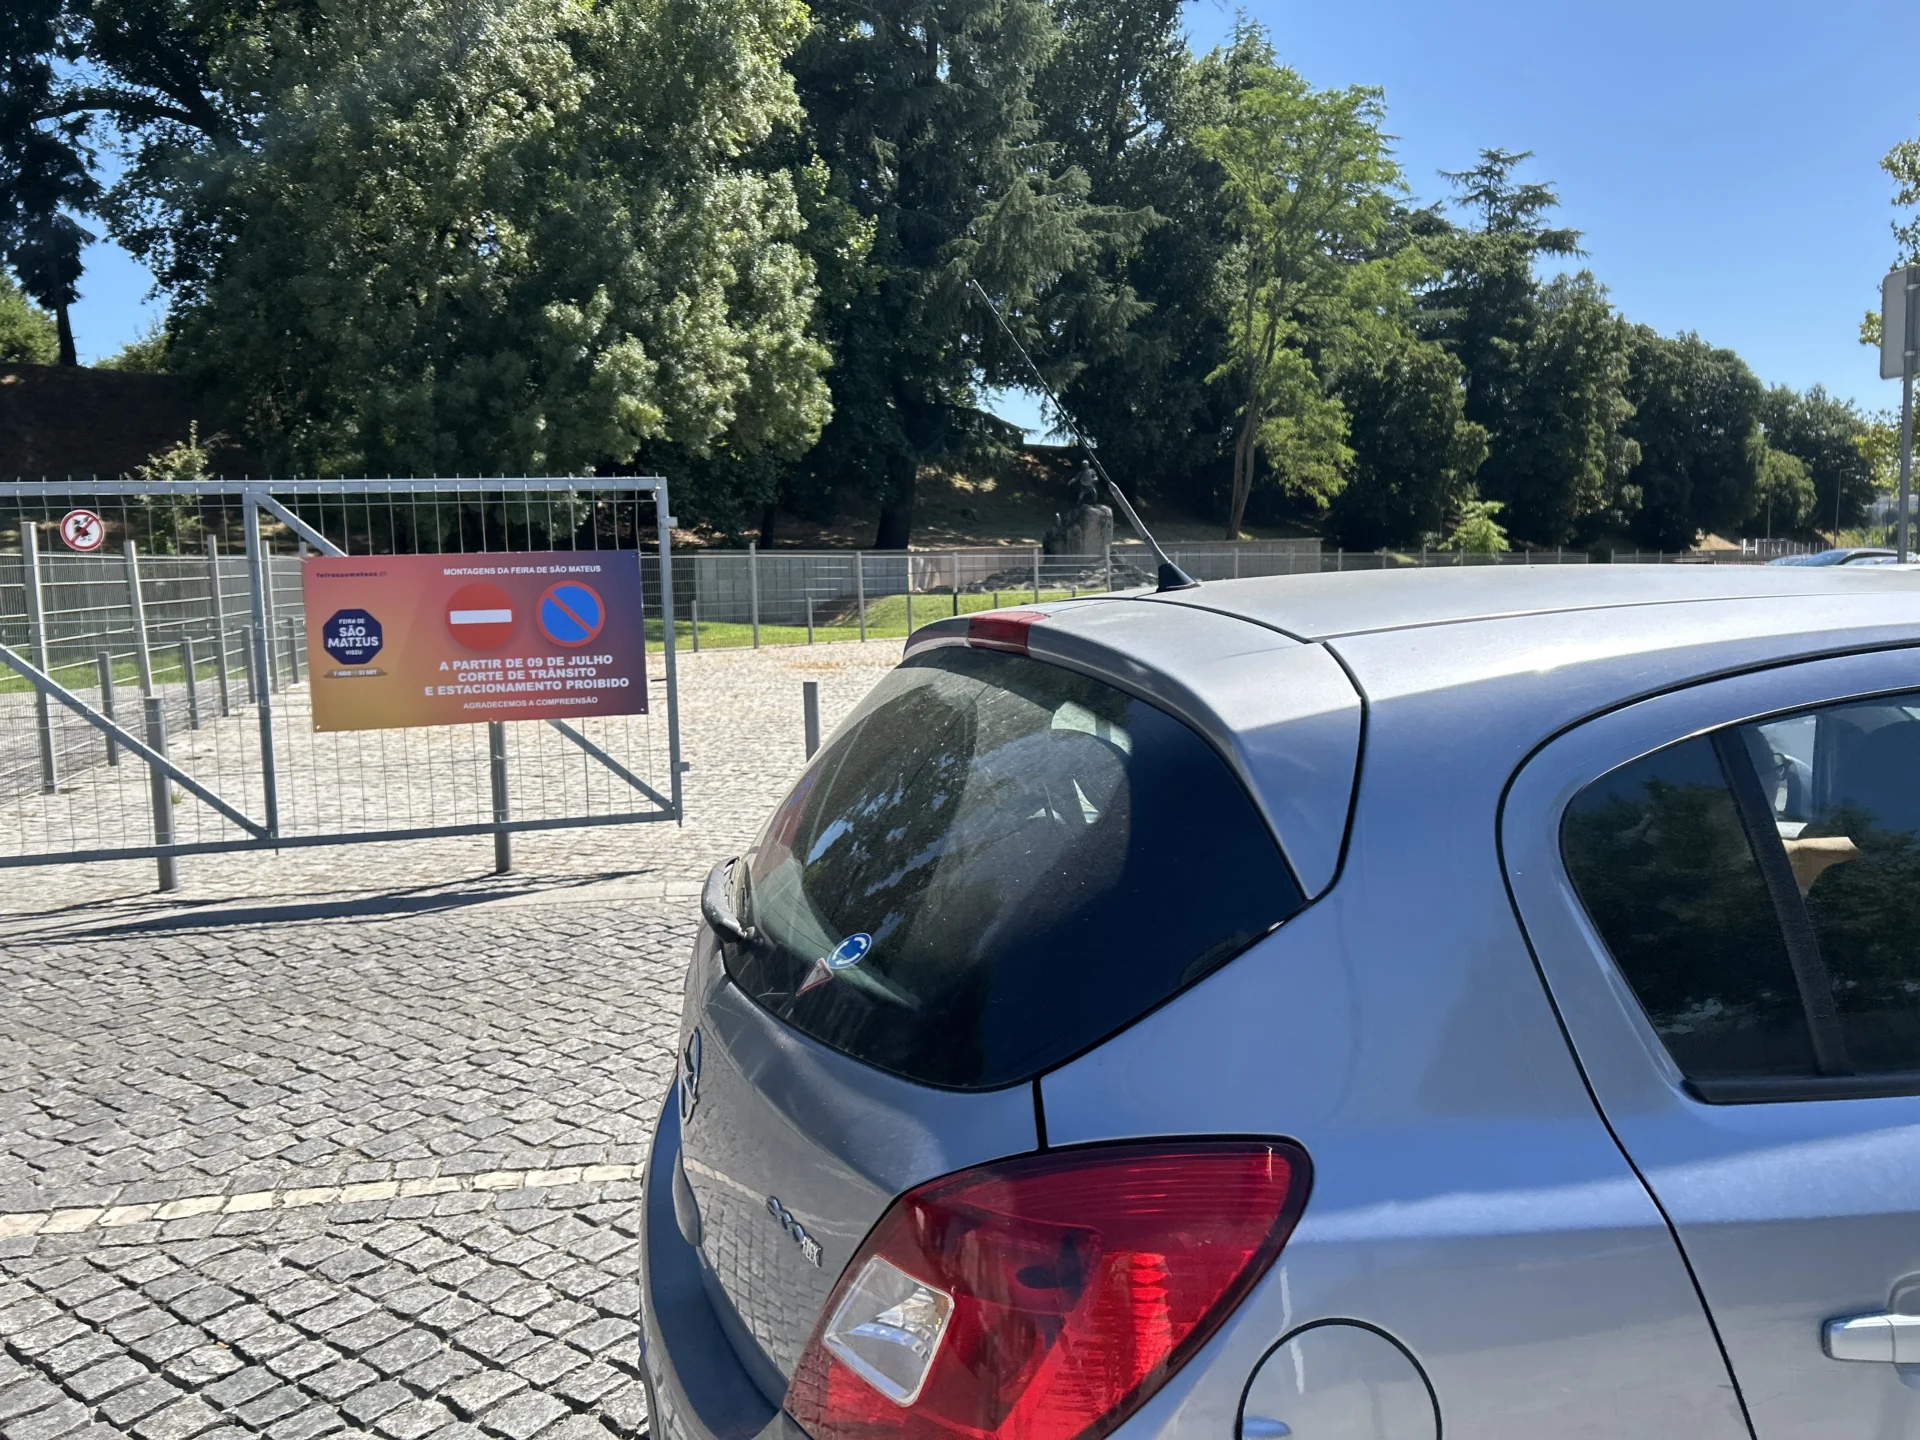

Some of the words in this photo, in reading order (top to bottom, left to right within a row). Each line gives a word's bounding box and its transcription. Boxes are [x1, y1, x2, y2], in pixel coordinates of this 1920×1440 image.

[444, 568, 496, 576] MONTAGENS
[498, 566, 510, 574] DA
[510, 566, 535, 574] FEIRA
[549, 564, 566, 574] SÃO
[568, 565, 602, 573] MATEUS
[339, 624, 366, 637] SÃO
[328, 636, 379, 648] MATEUS
[439, 661, 449, 671] A
[452, 659, 502, 670] PARTIR
[505, 658, 524, 668] DE
[527, 658, 543, 668] 09
[547, 656, 564, 667] DE
[568, 655, 612, 666] JULHO
[458, 672, 504, 682] CORTE
[508, 671, 526, 680] DE
[529, 667, 597, 679] TRÂNSITO
[424, 686, 434, 696] E
[437, 680, 563, 696] ESTACIONAMENTO
[566, 678, 630, 689] PROIBIDO
[463, 700, 528, 710] AGRADECEMOS
[536, 696, 598, 706] COMPREENSÃO
